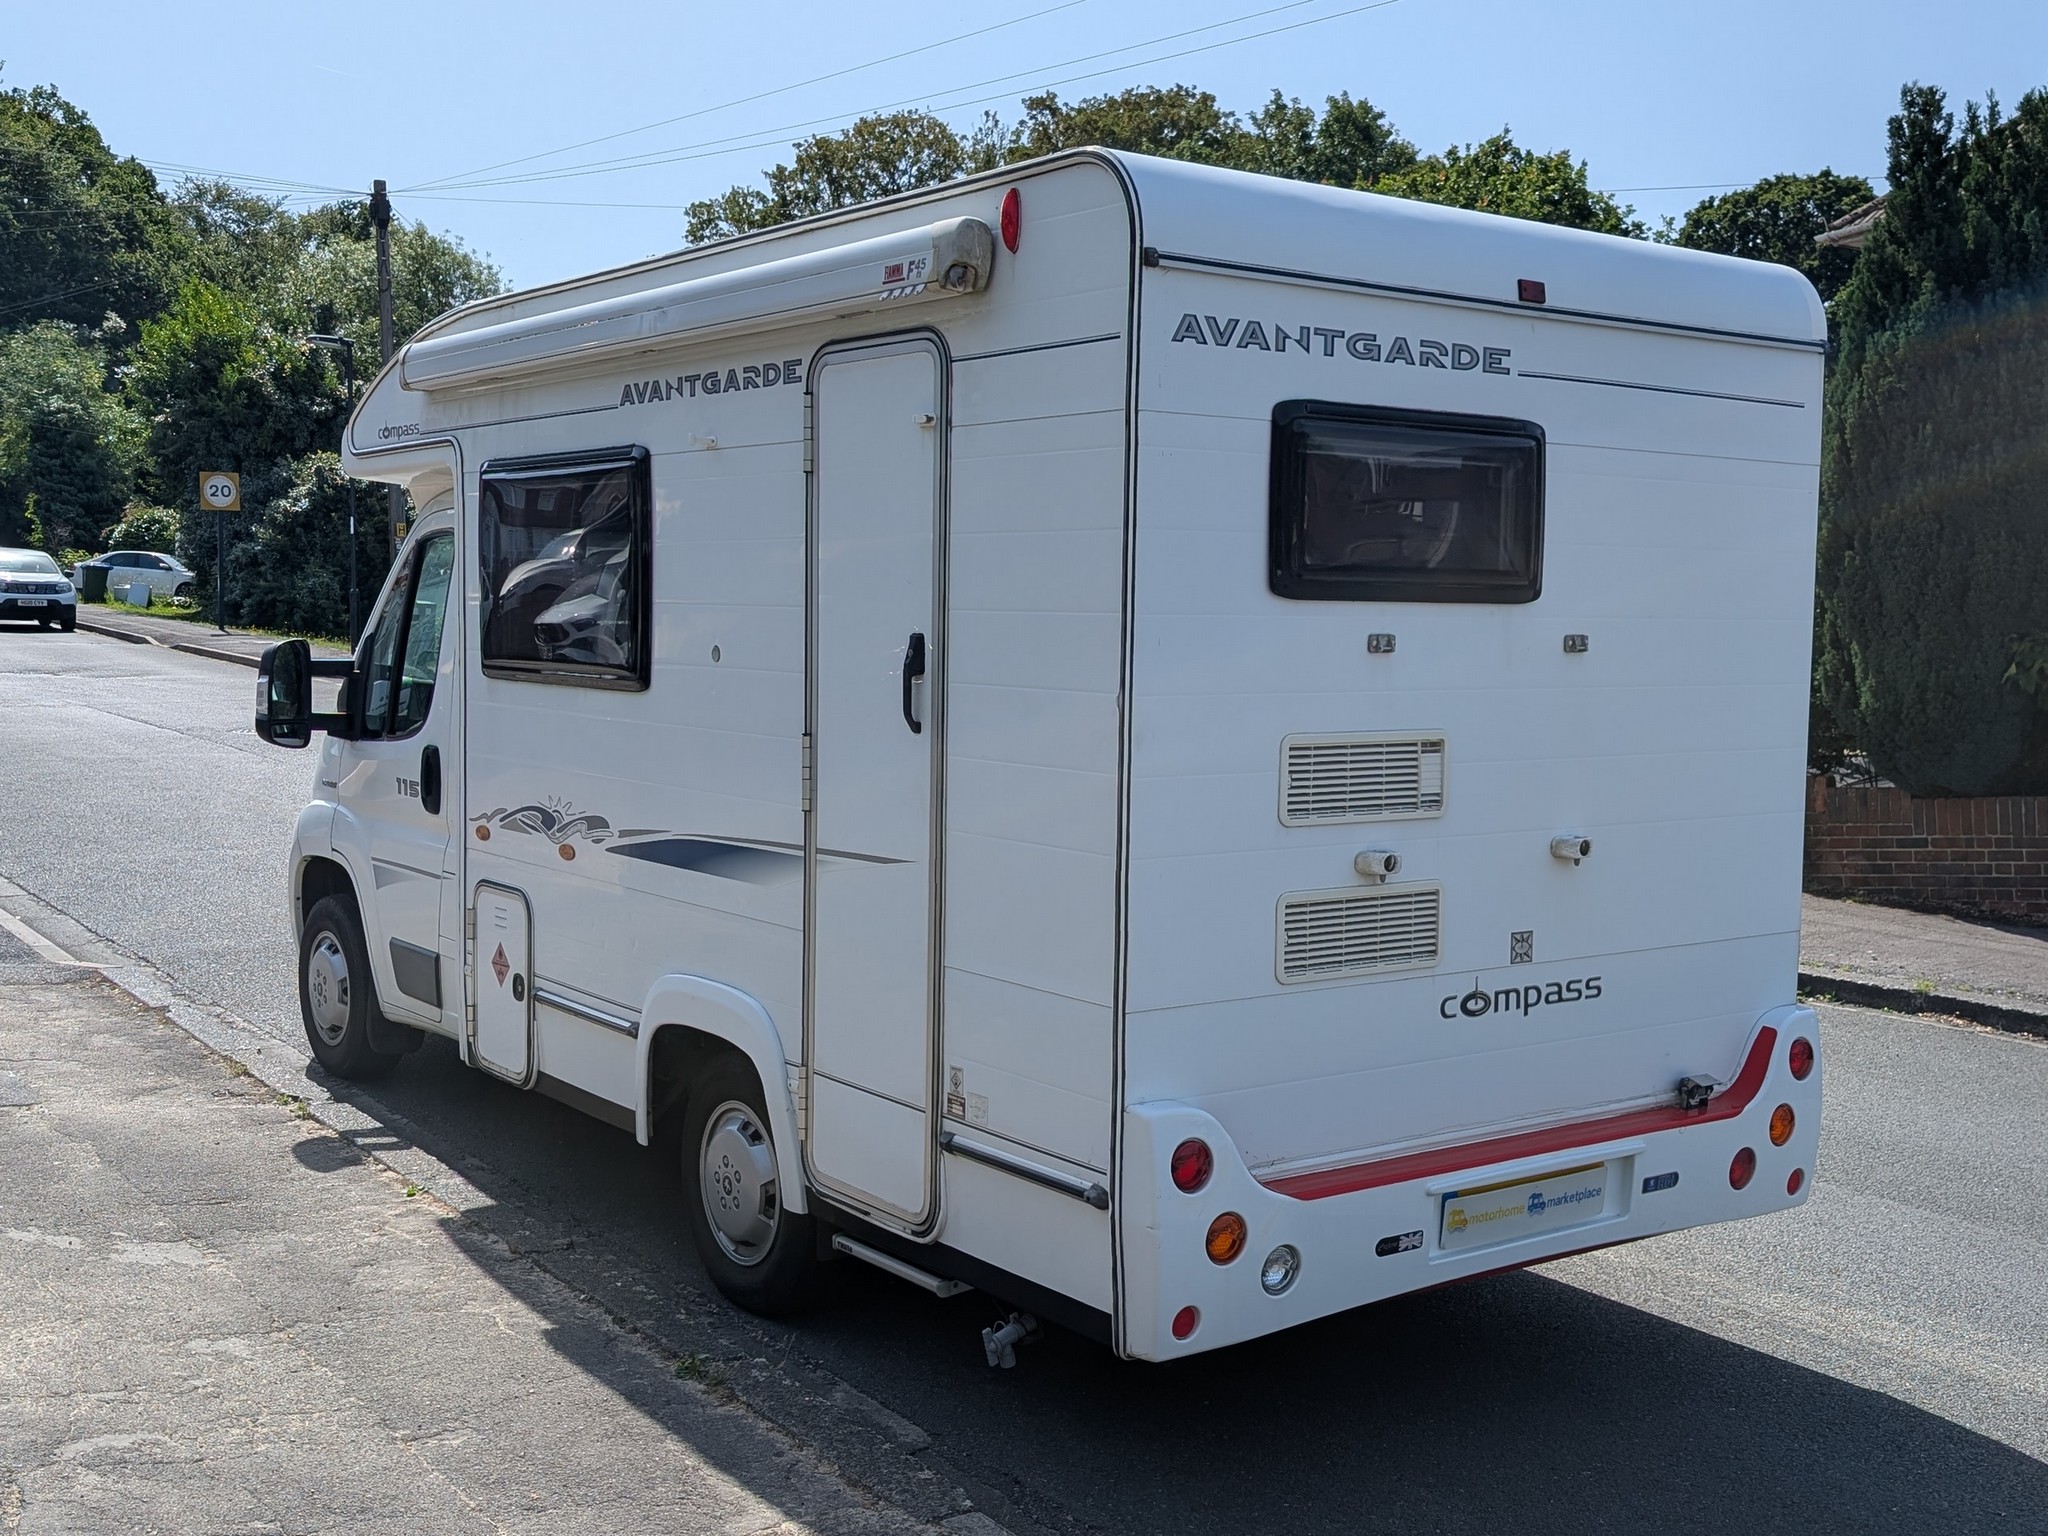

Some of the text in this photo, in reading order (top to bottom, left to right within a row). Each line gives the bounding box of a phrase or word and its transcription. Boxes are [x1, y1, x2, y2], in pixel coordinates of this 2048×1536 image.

[1171, 312, 1512, 376] AVANTGARDE
[619, 357, 803, 407] AVANTGARDE
[377, 419, 420, 441] compass
[208, 484, 232, 498] 20
[395, 776, 420, 799] 115
[1439, 975, 1603, 1020] compass
[1468, 1186, 1603, 1226] motorhome marketplace
